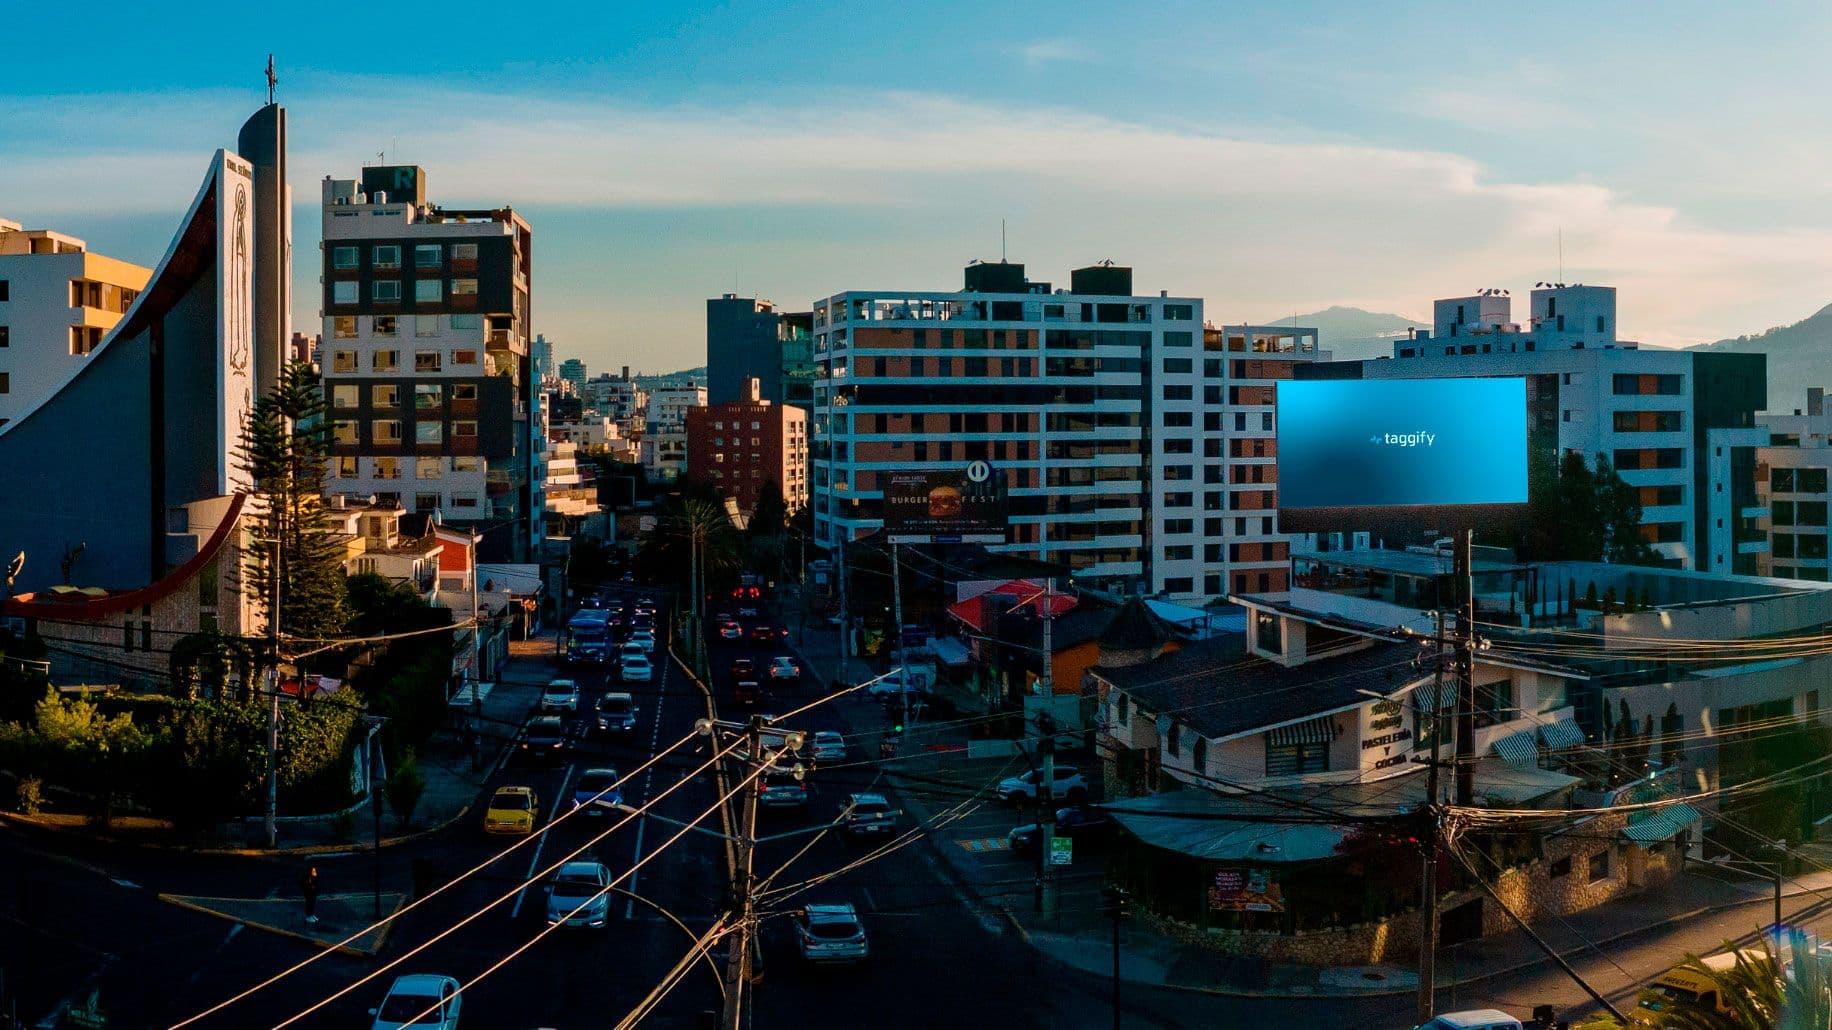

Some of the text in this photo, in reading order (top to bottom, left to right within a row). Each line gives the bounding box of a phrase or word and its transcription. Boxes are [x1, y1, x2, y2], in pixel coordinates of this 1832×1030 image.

[1384, 430, 1436, 447] taggify
[891, 495, 995, 504] BURGER FEST
[1384, 746, 1390, 756] Y
